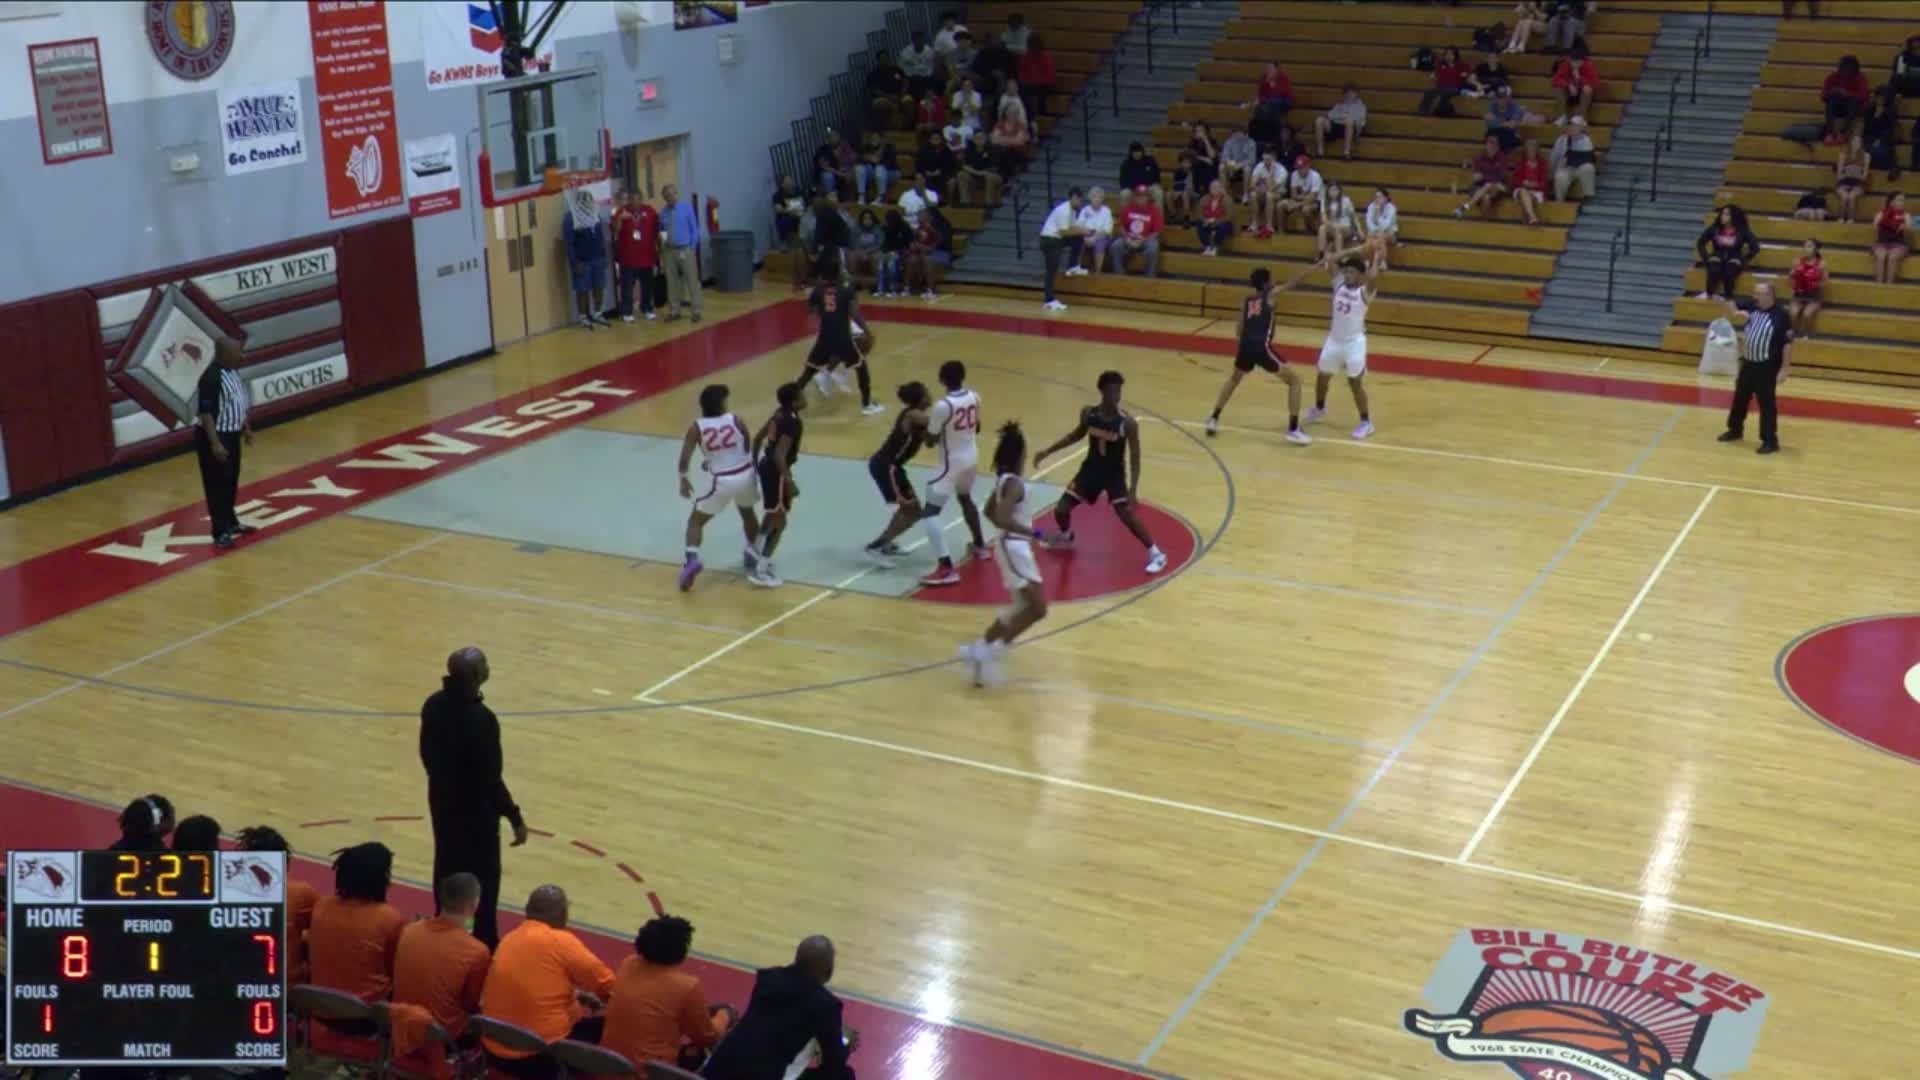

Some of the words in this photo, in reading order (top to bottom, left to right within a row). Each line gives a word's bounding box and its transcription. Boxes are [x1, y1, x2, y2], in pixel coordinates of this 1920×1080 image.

[429, 69, 442, 84] Go
[228, 152, 247, 166] Go
[249, 140, 302, 162] Conchs!
[236, 265, 275, 290] KEY
[281, 253, 329, 280] WEST
[263, 364, 334, 399] CONCHS
[953, 404, 977, 431] 20
[703, 425, 737, 452] 22
[88, 475, 364, 566] KEY
[336, 379, 637, 470] WEST
[1471, 929, 1568, 950] BILL
[1580, 939, 1766, 1006] BUTLER
[1481, 946, 1753, 1015] COURT
[1470, 1044, 1504, 1053] 1968
[1509, 1045, 1553, 1055] STATE
[1559, 1050, 1638, 1080] CHAMPIO
